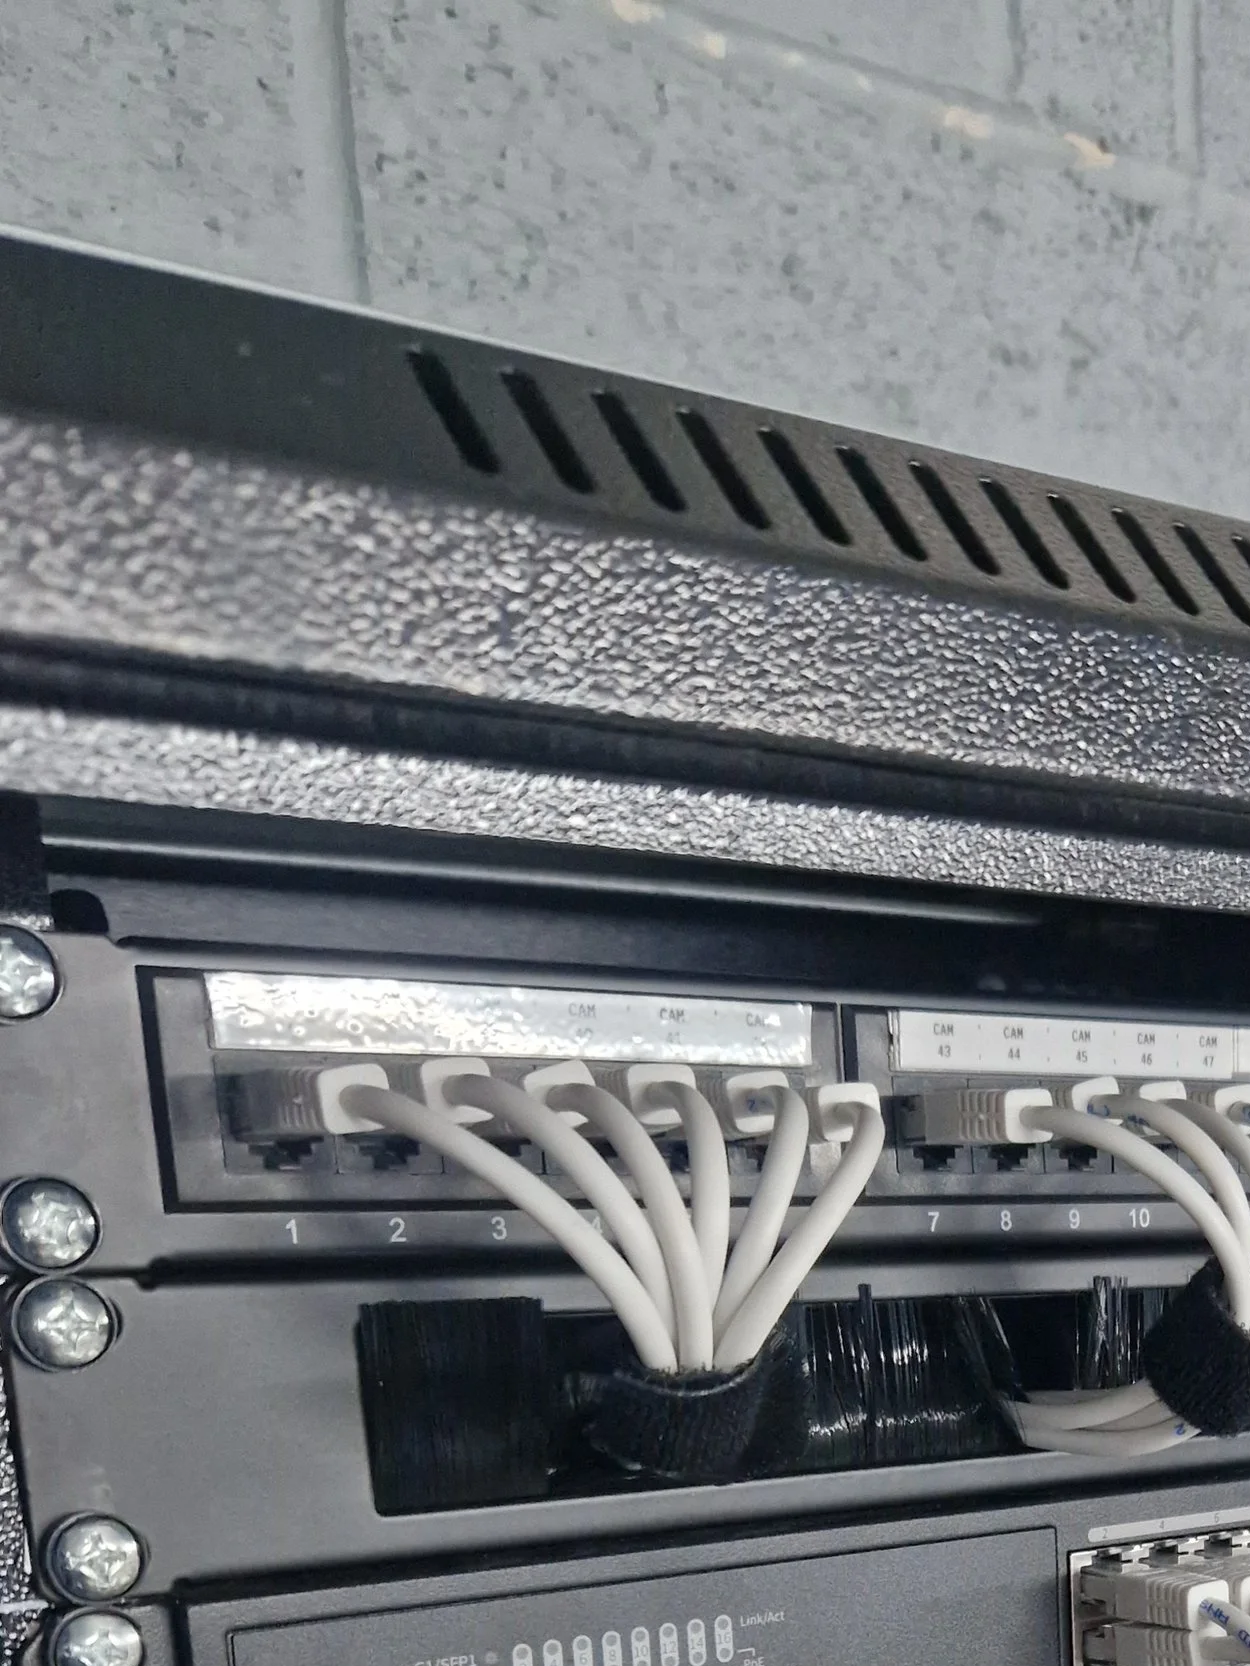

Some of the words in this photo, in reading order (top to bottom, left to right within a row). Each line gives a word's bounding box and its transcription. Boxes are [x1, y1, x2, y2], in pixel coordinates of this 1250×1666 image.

[568, 1003, 597, 1018] CAM
[659, 1007, 685, 1023] CAM
[933, 1023, 954, 1037] CAM
[1003, 1026, 1024, 1040] CAM
[1071, 1029, 1091, 1043] CAM
[1137, 1032, 1156, 1045] CAM
[1199, 1035, 1218, 1049] CAM
[937, 1046, 951, 1059] 43
[1007, 1048, 1021, 1061] 44
[1075, 1050, 1088, 1064] 45
[1141, 1052, 1153, 1066] 46
[1202, 1054, 1215, 1068] 47
[285, 1217, 299, 1246] 1
[388, 1216, 408, 1243] 2
[491, 1216, 507, 1240] 3
[928, 1211, 940, 1233] 7
[1000, 1209, 1012, 1231] 8
[1068, 1208, 1080, 1229] 9
[1128, 1207, 1150, 1228] 10
[1102, 1529, 1109, 1540] 2
[1159, 1519, 1165, 1530] 4
[740, 1611, 785, 1628] Link/Act
[579, 1655, 587, 1666] 6
[609, 1650, 617, 1662] 8
[635, 1646, 648, 1657] 10
[662, 1642, 677, 1654] 12
[690, 1638, 705, 1650] 14
[718, 1633, 732, 1645] 16
